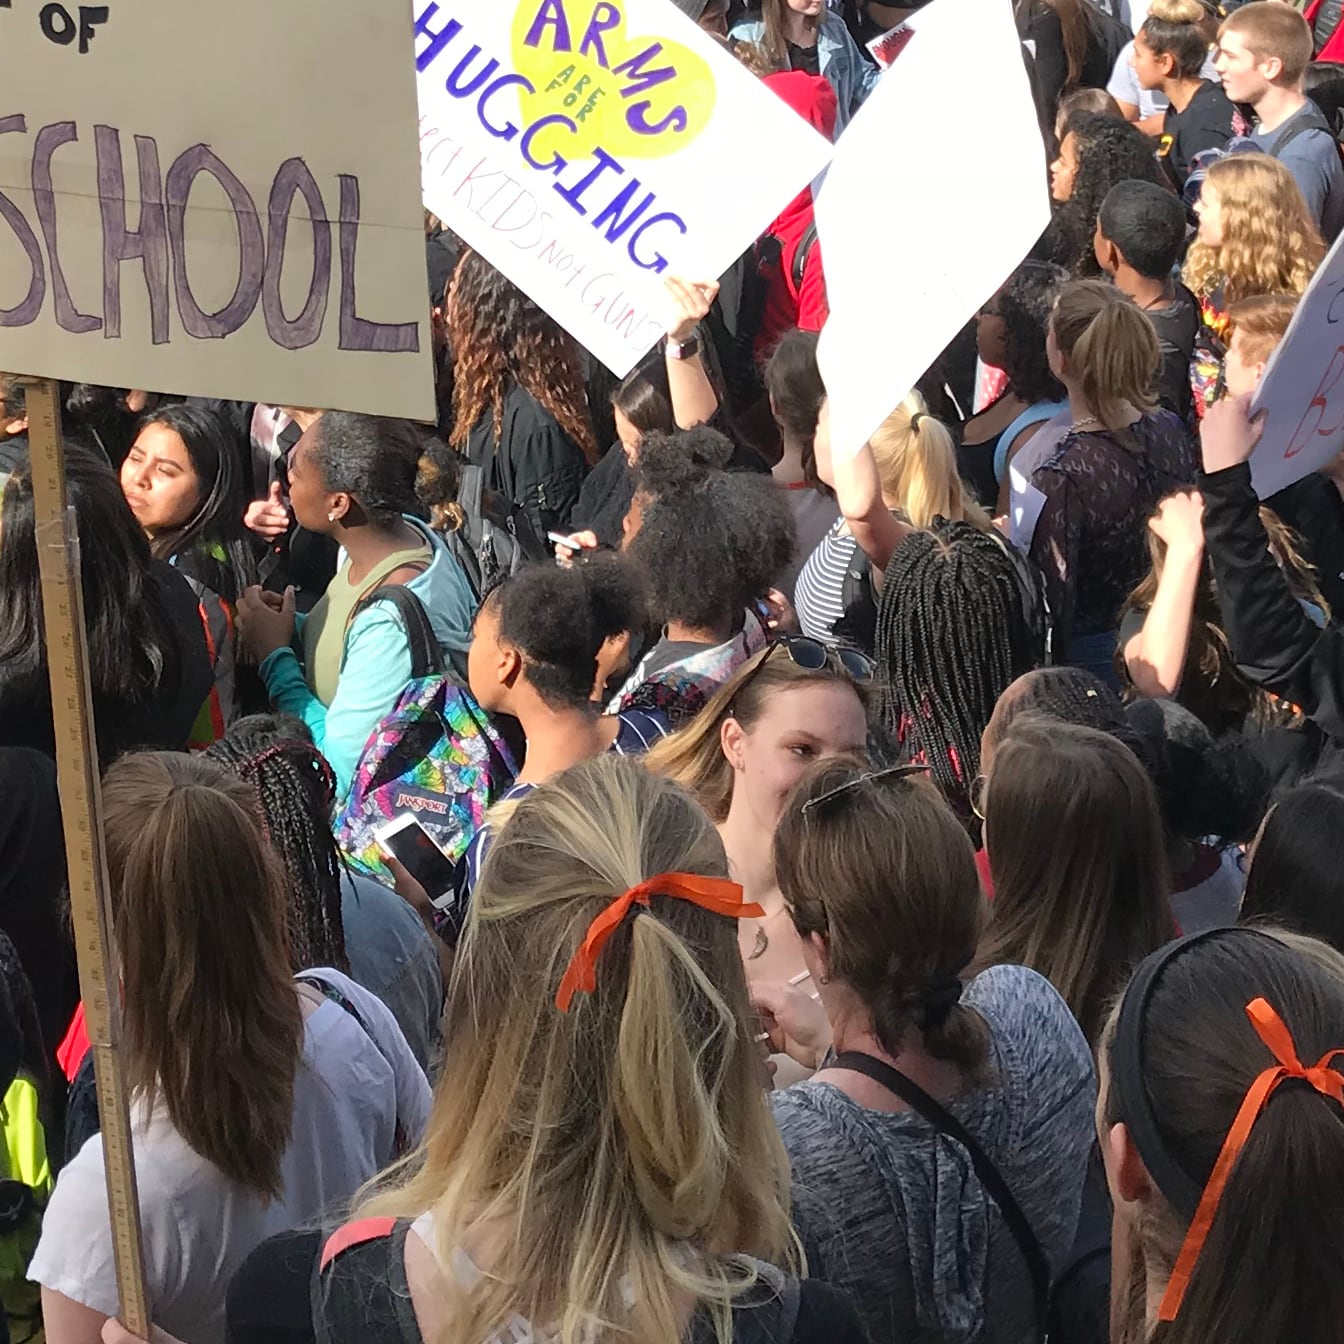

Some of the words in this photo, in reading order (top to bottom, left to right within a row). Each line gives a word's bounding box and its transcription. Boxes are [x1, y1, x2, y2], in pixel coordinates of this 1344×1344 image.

[38, 1, 110, 56] OF
[544, 79, 594, 124] FOR
[555, 62, 606, 111] ARE
[413, 1, 688, 276] HUGGING
[452, 156, 552, 253] KIDS
[395, 792, 448, 815] JANSPORT
